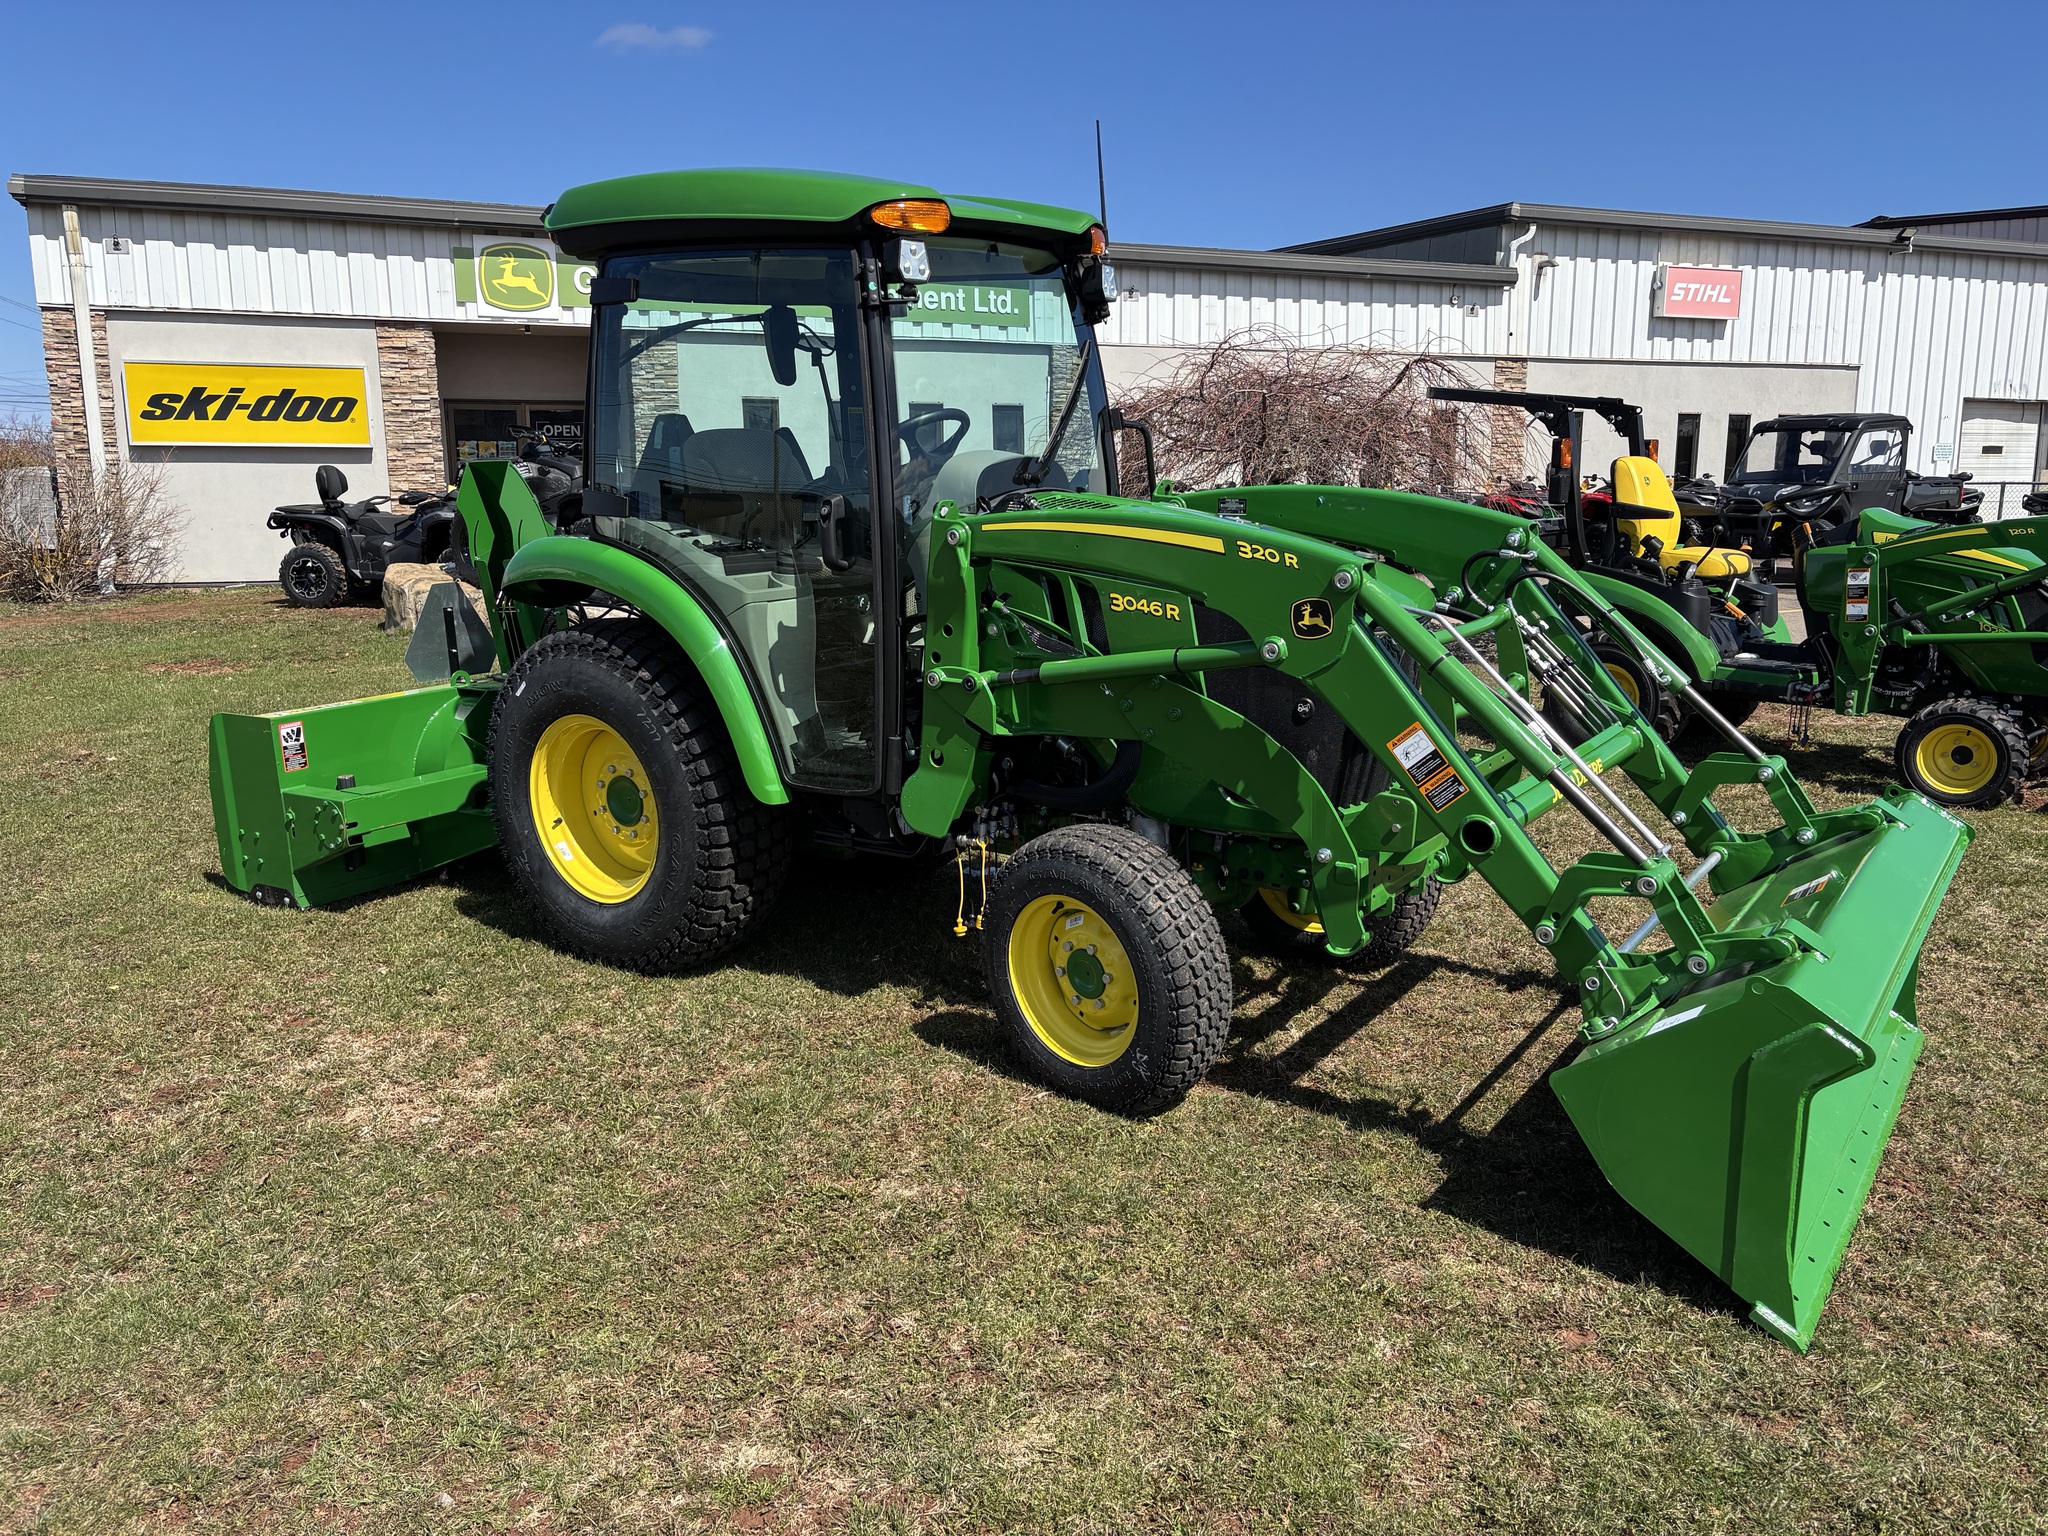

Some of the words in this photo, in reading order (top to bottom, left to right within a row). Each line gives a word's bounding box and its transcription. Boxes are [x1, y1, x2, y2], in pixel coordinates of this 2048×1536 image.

[974, 288, 1019, 315] Ltd.
[1670, 282, 1732, 304] STIHL
[139, 386, 358, 422] ski-doo
[543, 424, 581, 437] OPEN
[2008, 528, 2027, 536] 120
[2027, 527, 2036, 535] R
[1236, 540, 1280, 564] 320
[1284, 552, 1300, 570] R
[1109, 592, 1163, 617] 3046
[1166, 603, 1181, 622] R
[1396, 726, 1418, 744] WARNING
[1429, 770, 1452, 788] WARNING
[1029, 868, 1123, 913] GALAXY
